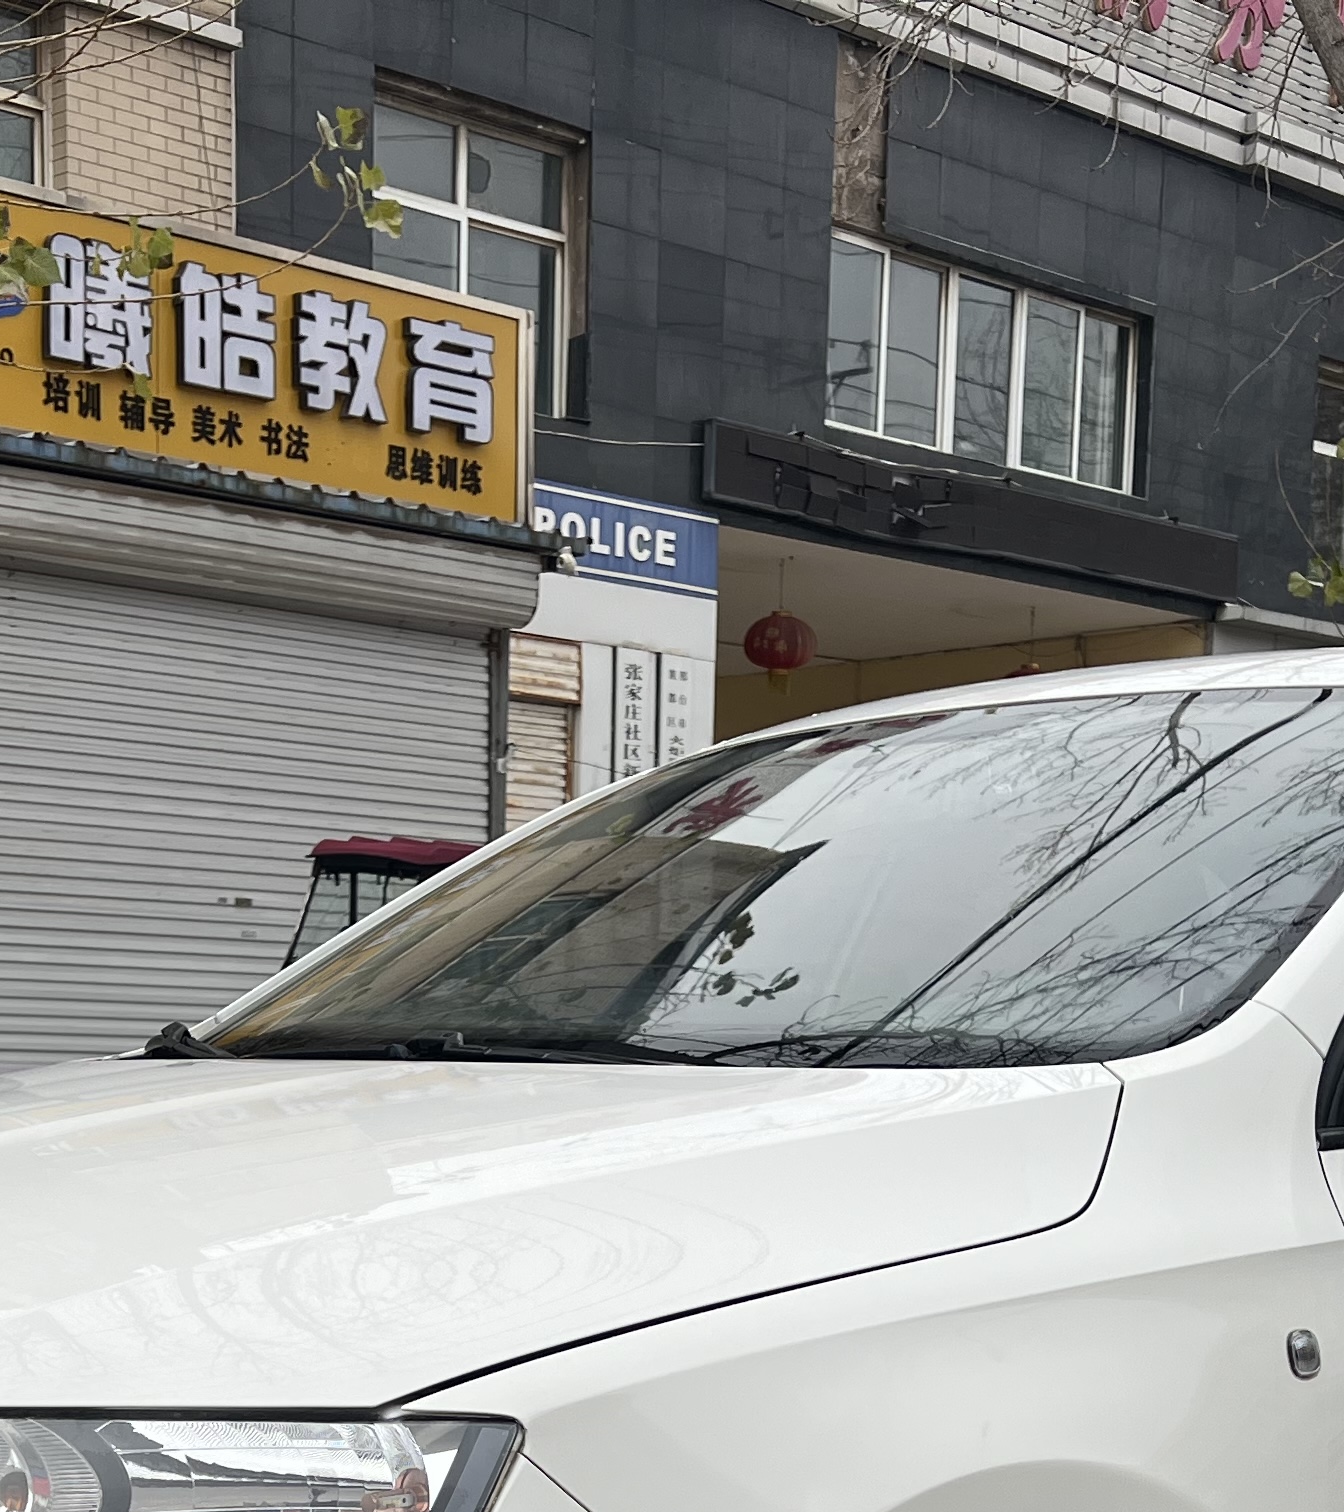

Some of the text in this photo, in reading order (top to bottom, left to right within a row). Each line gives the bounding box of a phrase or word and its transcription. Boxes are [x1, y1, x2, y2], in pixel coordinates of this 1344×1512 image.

[44, 232, 496, 444] 曦皓教育
[43, 373, 483, 495] 培训 辅导 美术 书法 思维训练
[534, 506, 677, 567] POLICE
